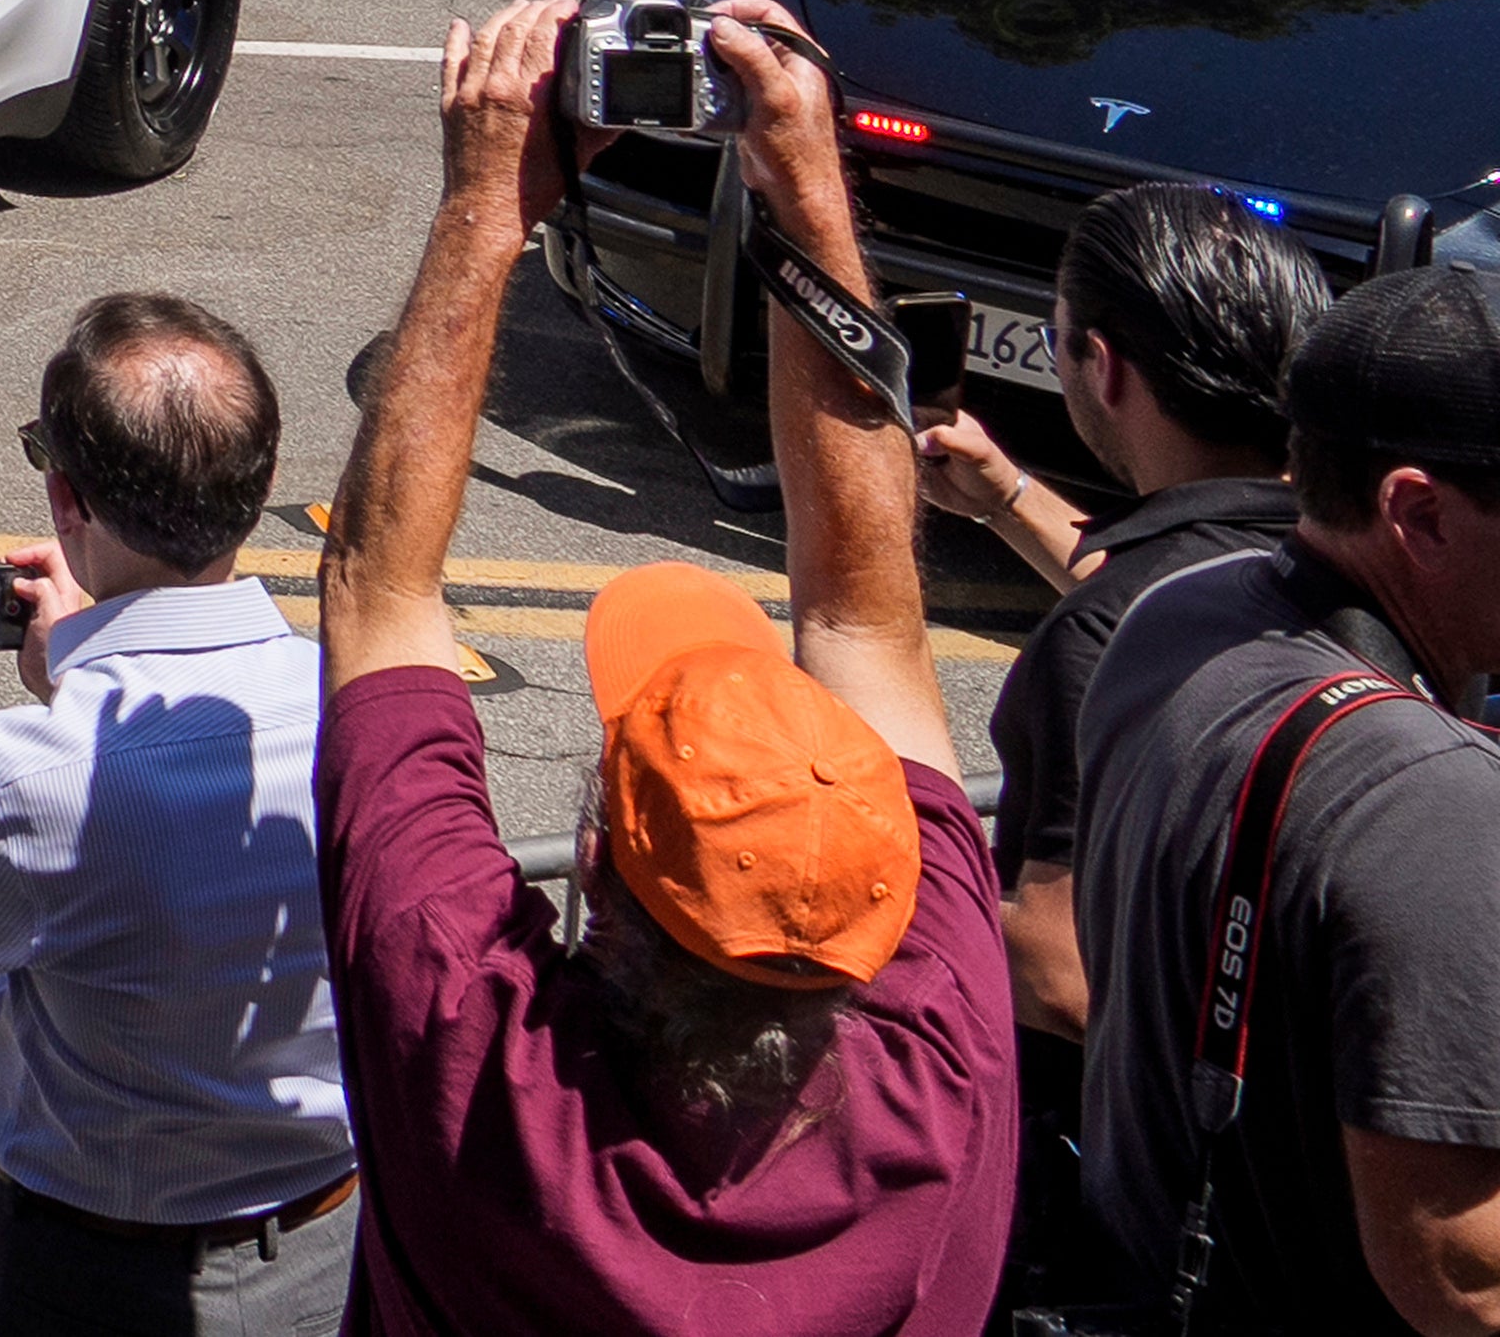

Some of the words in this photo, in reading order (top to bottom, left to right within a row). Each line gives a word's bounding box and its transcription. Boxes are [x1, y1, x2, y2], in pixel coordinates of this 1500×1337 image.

[779, 259, 873, 351] Canon
[966, 311, 1060, 378] 162
[1221, 894, 1251, 980] EOS
[1214, 986, 1238, 1030] 7D
